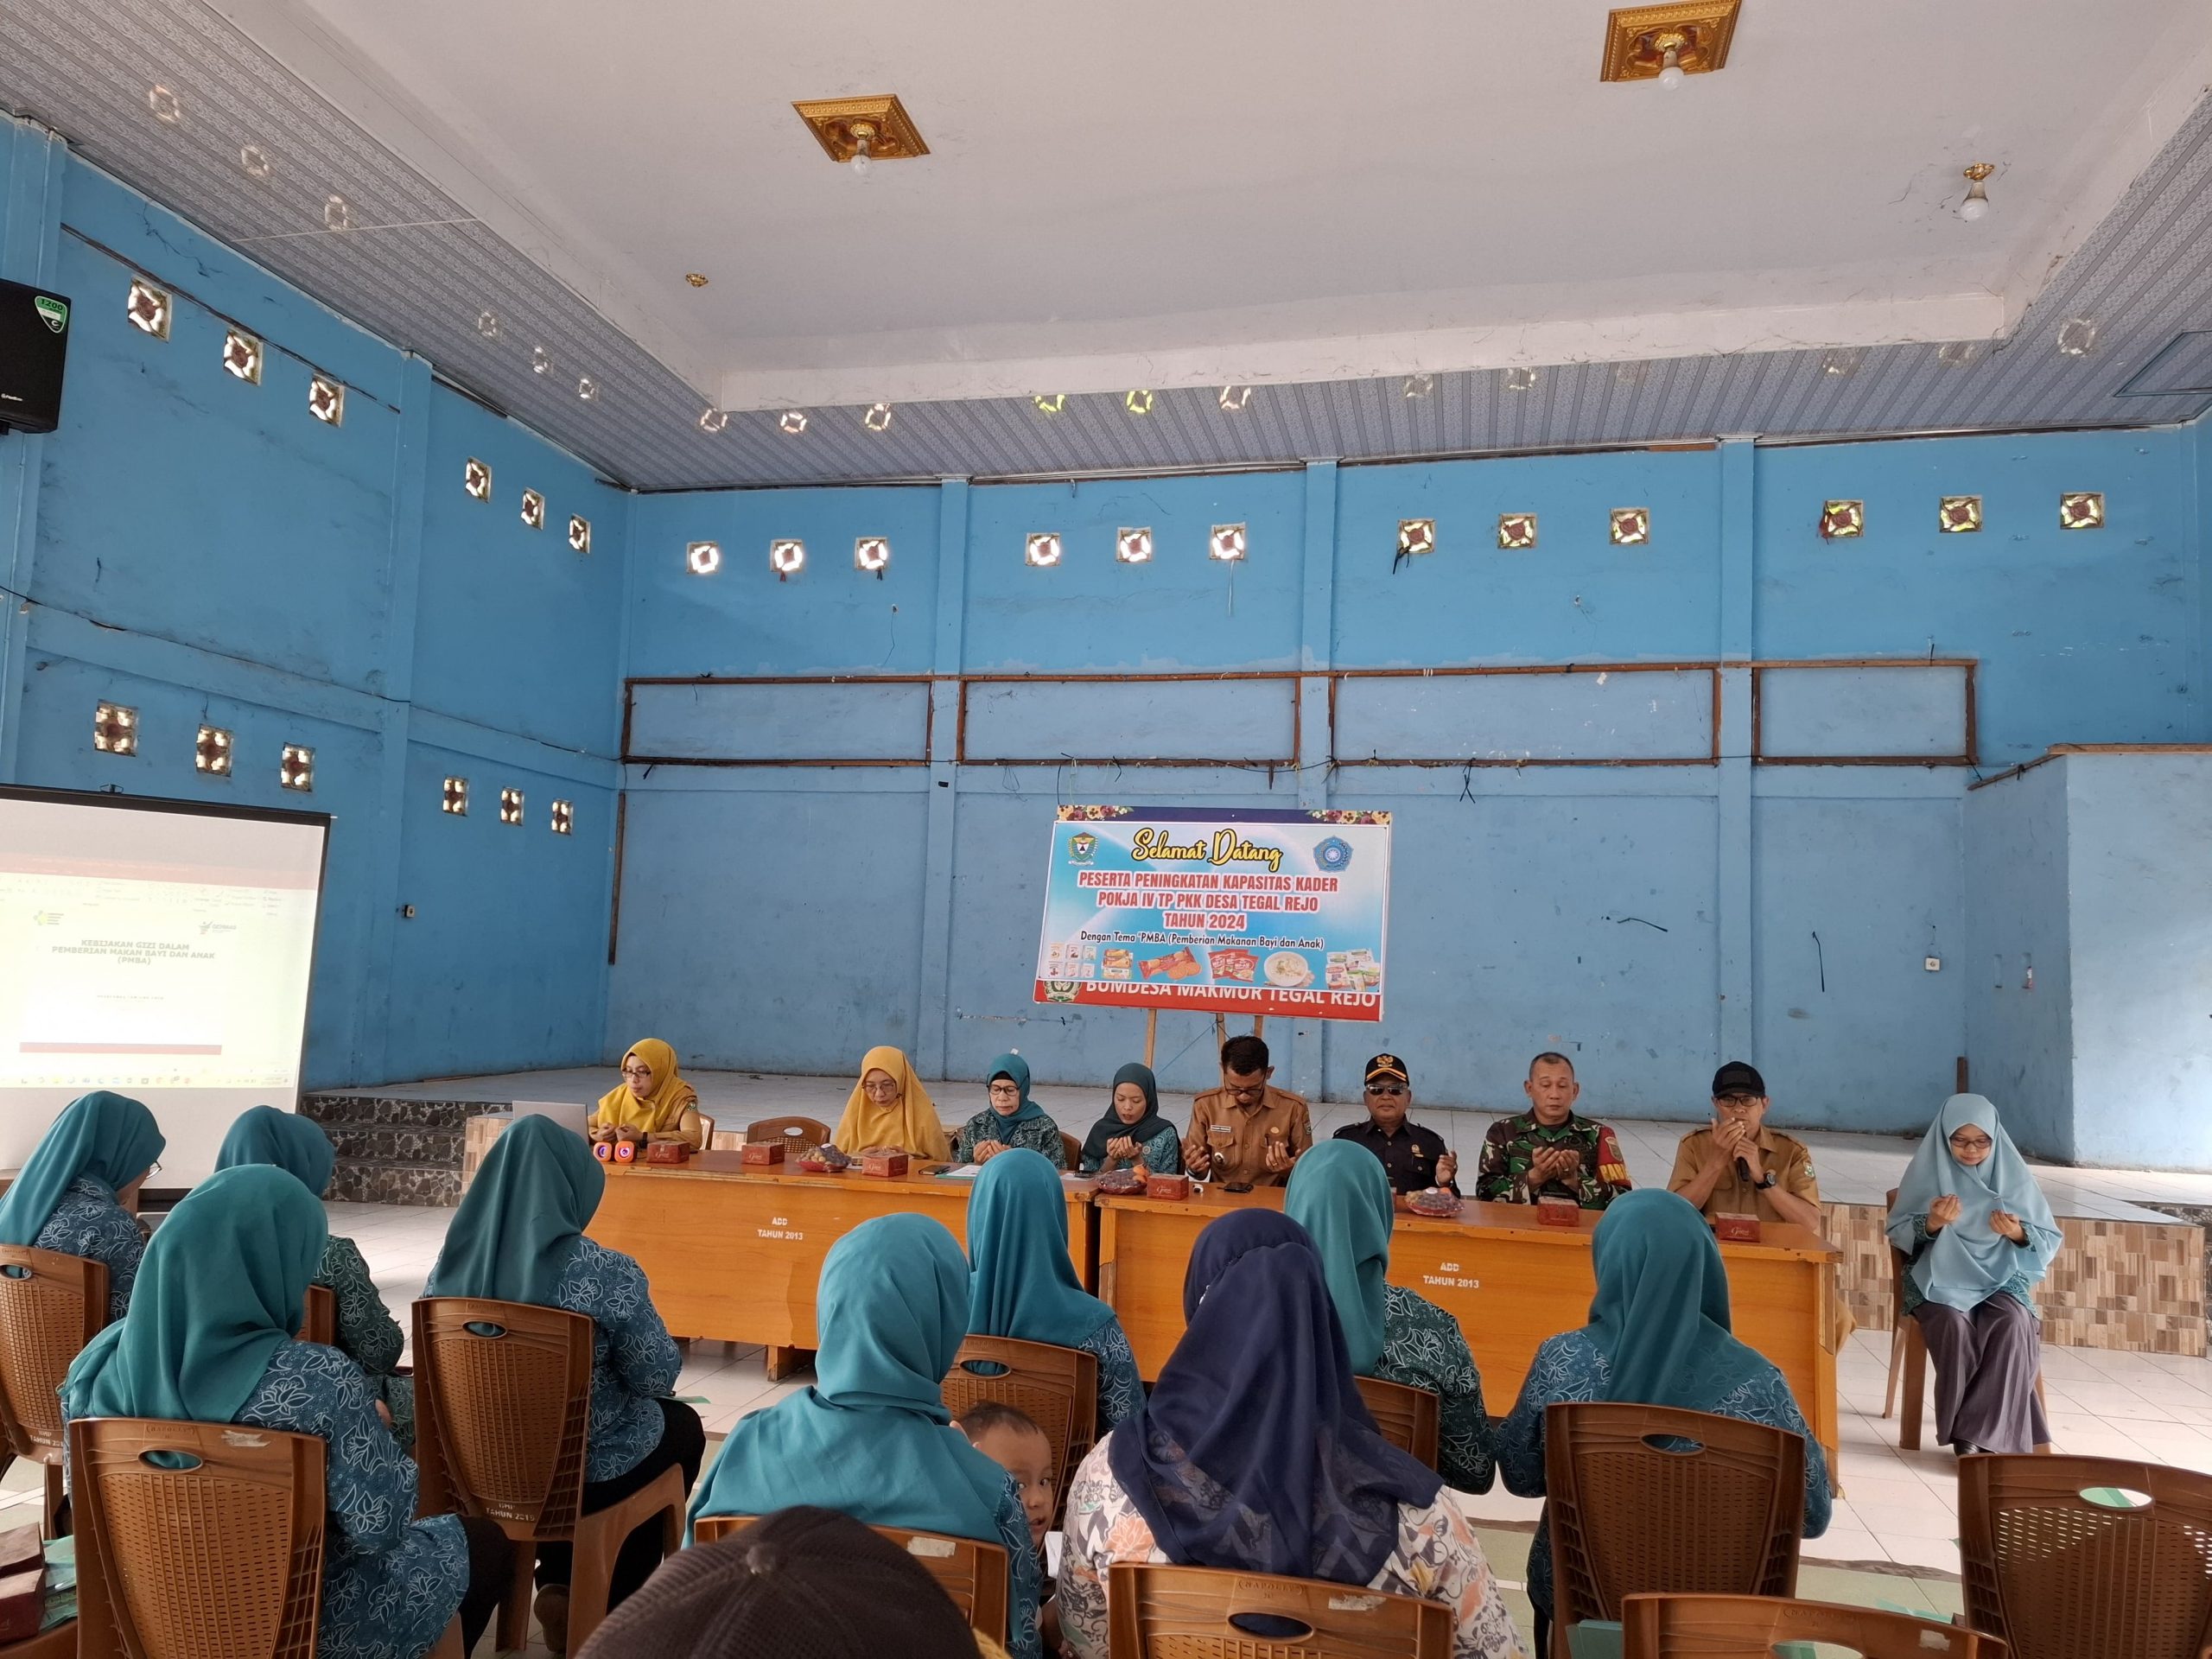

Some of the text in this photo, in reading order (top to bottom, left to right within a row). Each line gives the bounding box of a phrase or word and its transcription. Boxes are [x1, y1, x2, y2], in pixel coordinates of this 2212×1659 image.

[41, 298, 63, 311] 1200
[1132, 828, 1283, 873] Selamat Datang
[1079, 872, 1338, 892] PESERTA PENINGKATAN KAPASITAS KADER
[1098, 892, 1319, 912] POKJA IV TP PKK DESA TEGAL REJO
[1165, 912, 1245, 929] TAHUN 2024
[1081, 931, 1111, 943] Dengan
[1115, 931, 1135, 942] Tema
[1168, 933, 1215, 944] (Pemberian
[1217, 936, 1256, 946] Makanan
[1260, 937, 1277, 949] Bayi
[1281, 938, 1295, 947] dan
[1299, 938, 1324, 949] Anak)
[1178, 986, 1262, 1001] MAKMUR
[1270, 989, 1325, 1004] TEGAL
[1332, 992, 1376, 1007] REJO
[772, 1217, 788, 1225] ADD
[757, 1229, 804, 1240] TAHUN 2013
[1440, 1262, 1459, 1272] ADD
[1423, 1274, 1479, 1288] TAHUN 2013
[486, 1507, 512, 1518] TAHUN
